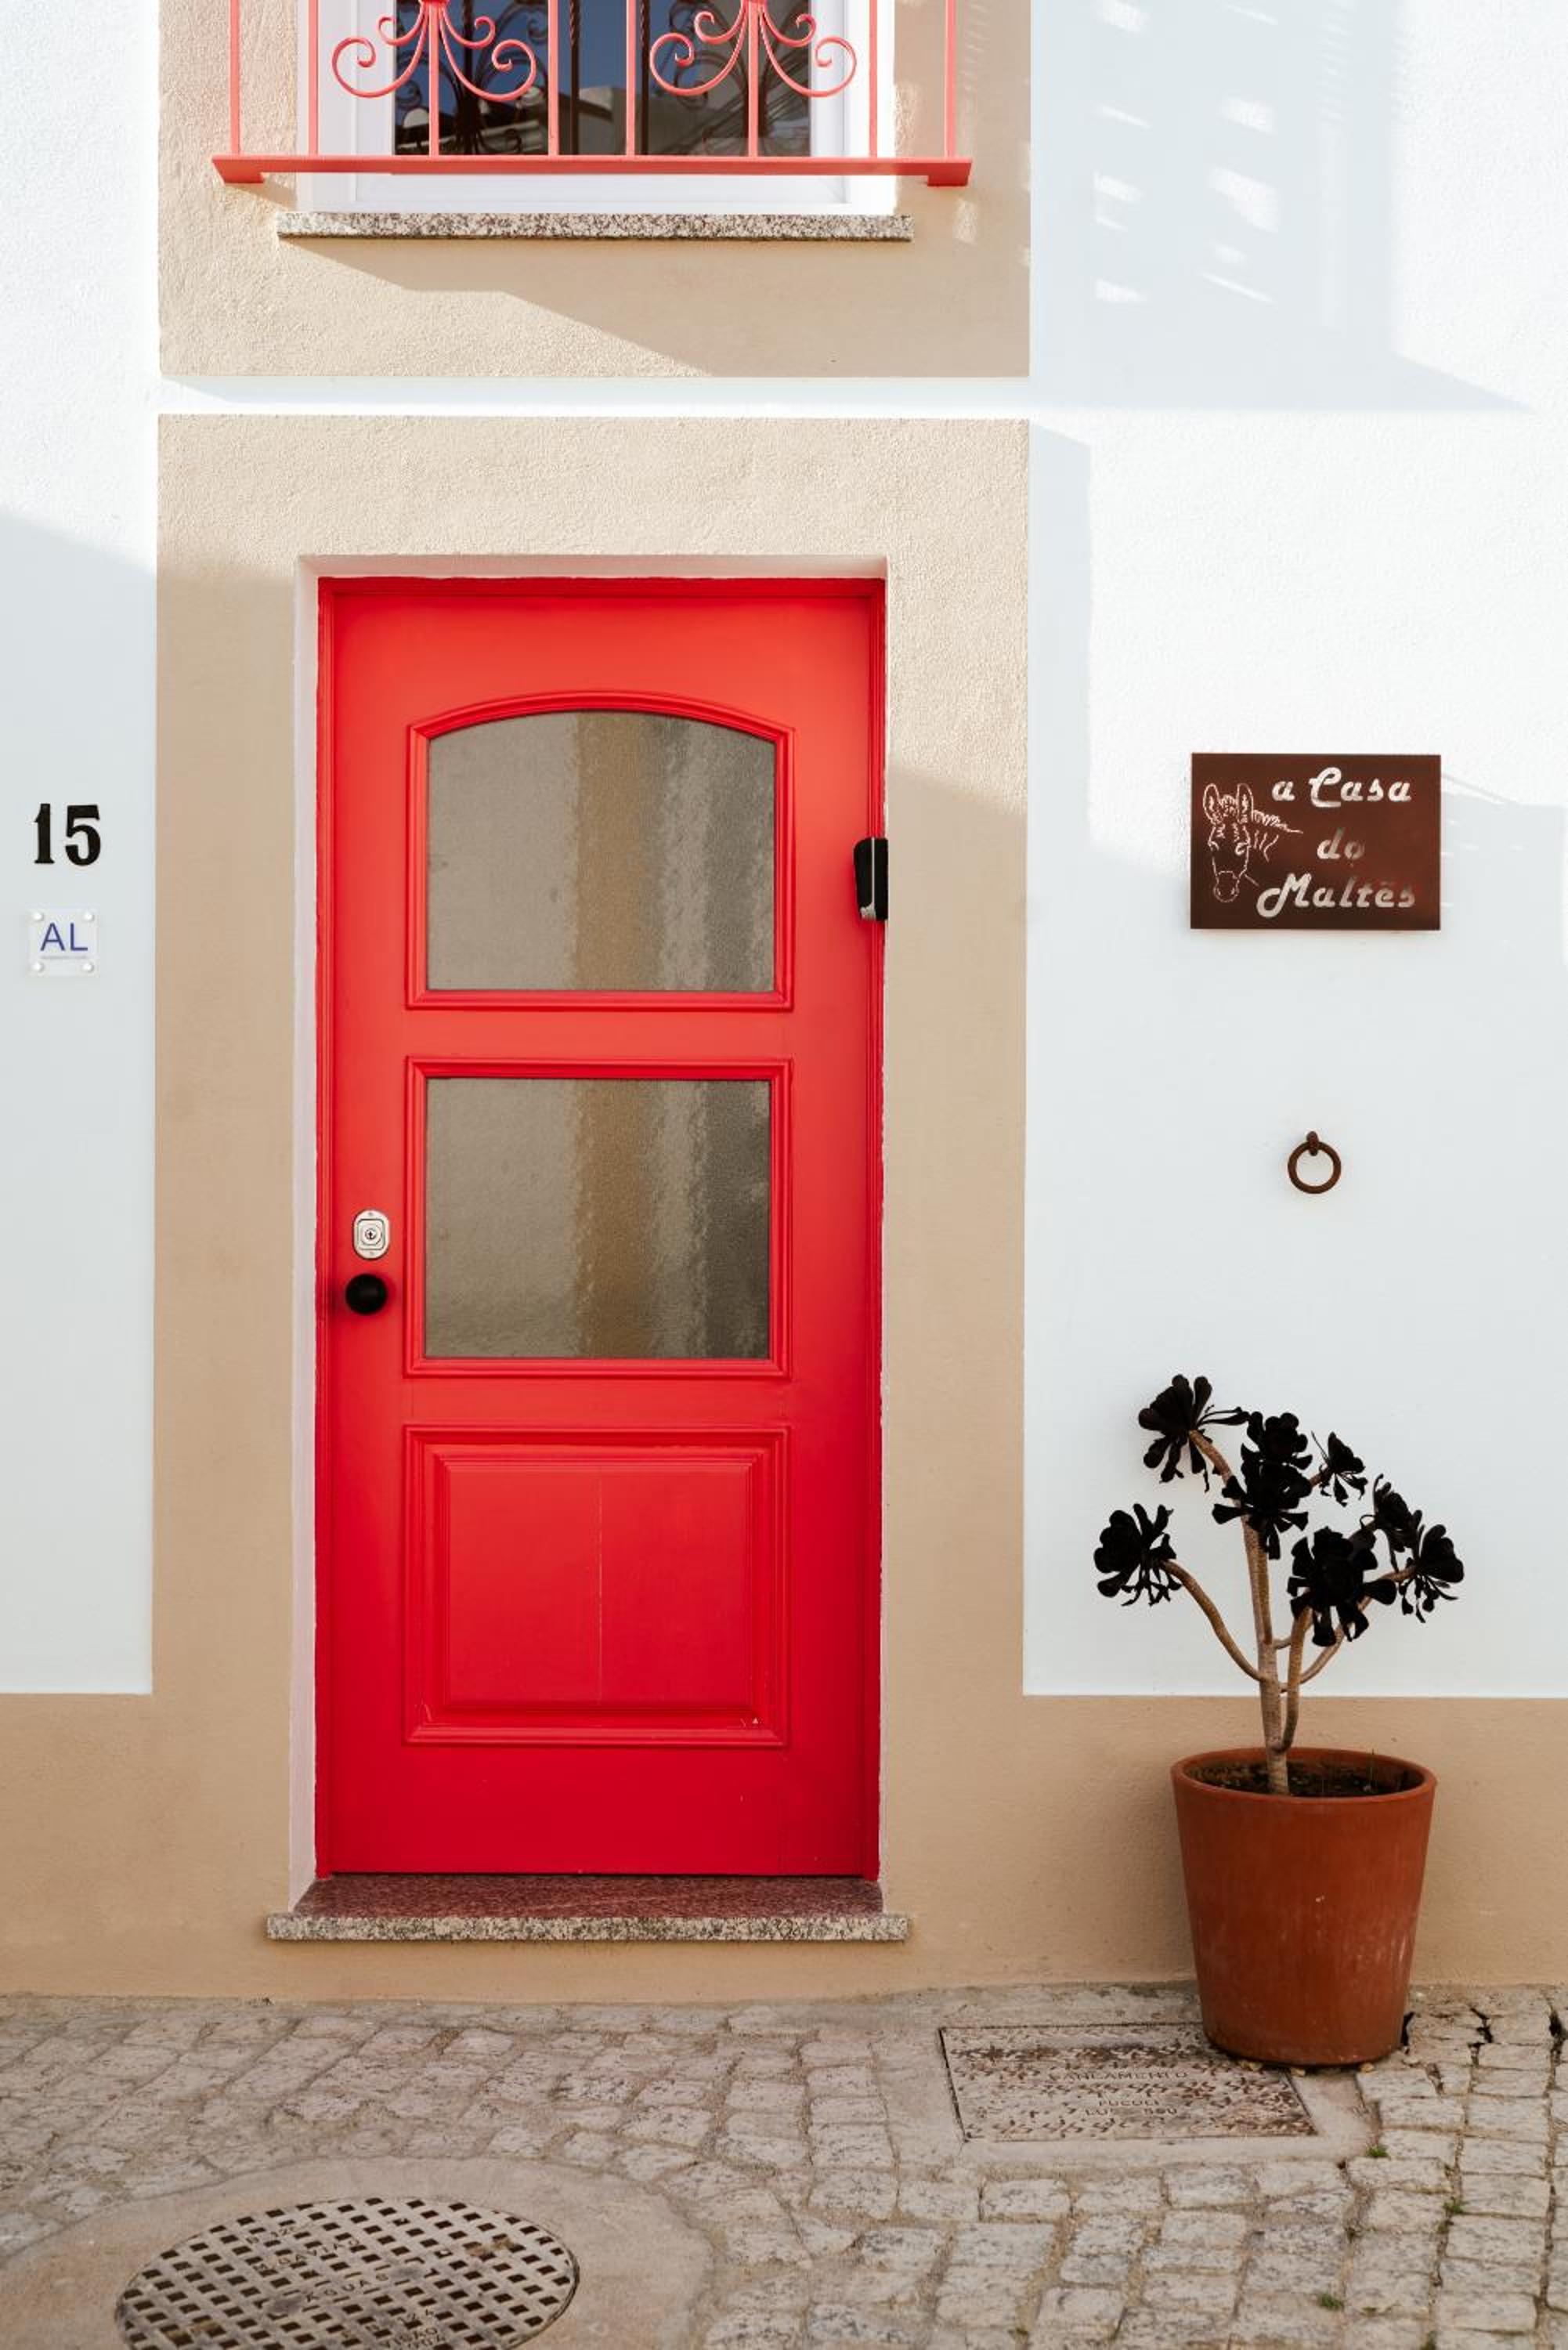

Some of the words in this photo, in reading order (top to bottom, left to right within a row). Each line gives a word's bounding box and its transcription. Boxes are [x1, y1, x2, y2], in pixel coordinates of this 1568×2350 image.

[1272, 779, 1295, 801] a
[1309, 767, 1412, 808] Casa
[34, 803, 101, 866] 15
[1317, 828, 1365, 860] do
[40, 922, 89, 952] AL
